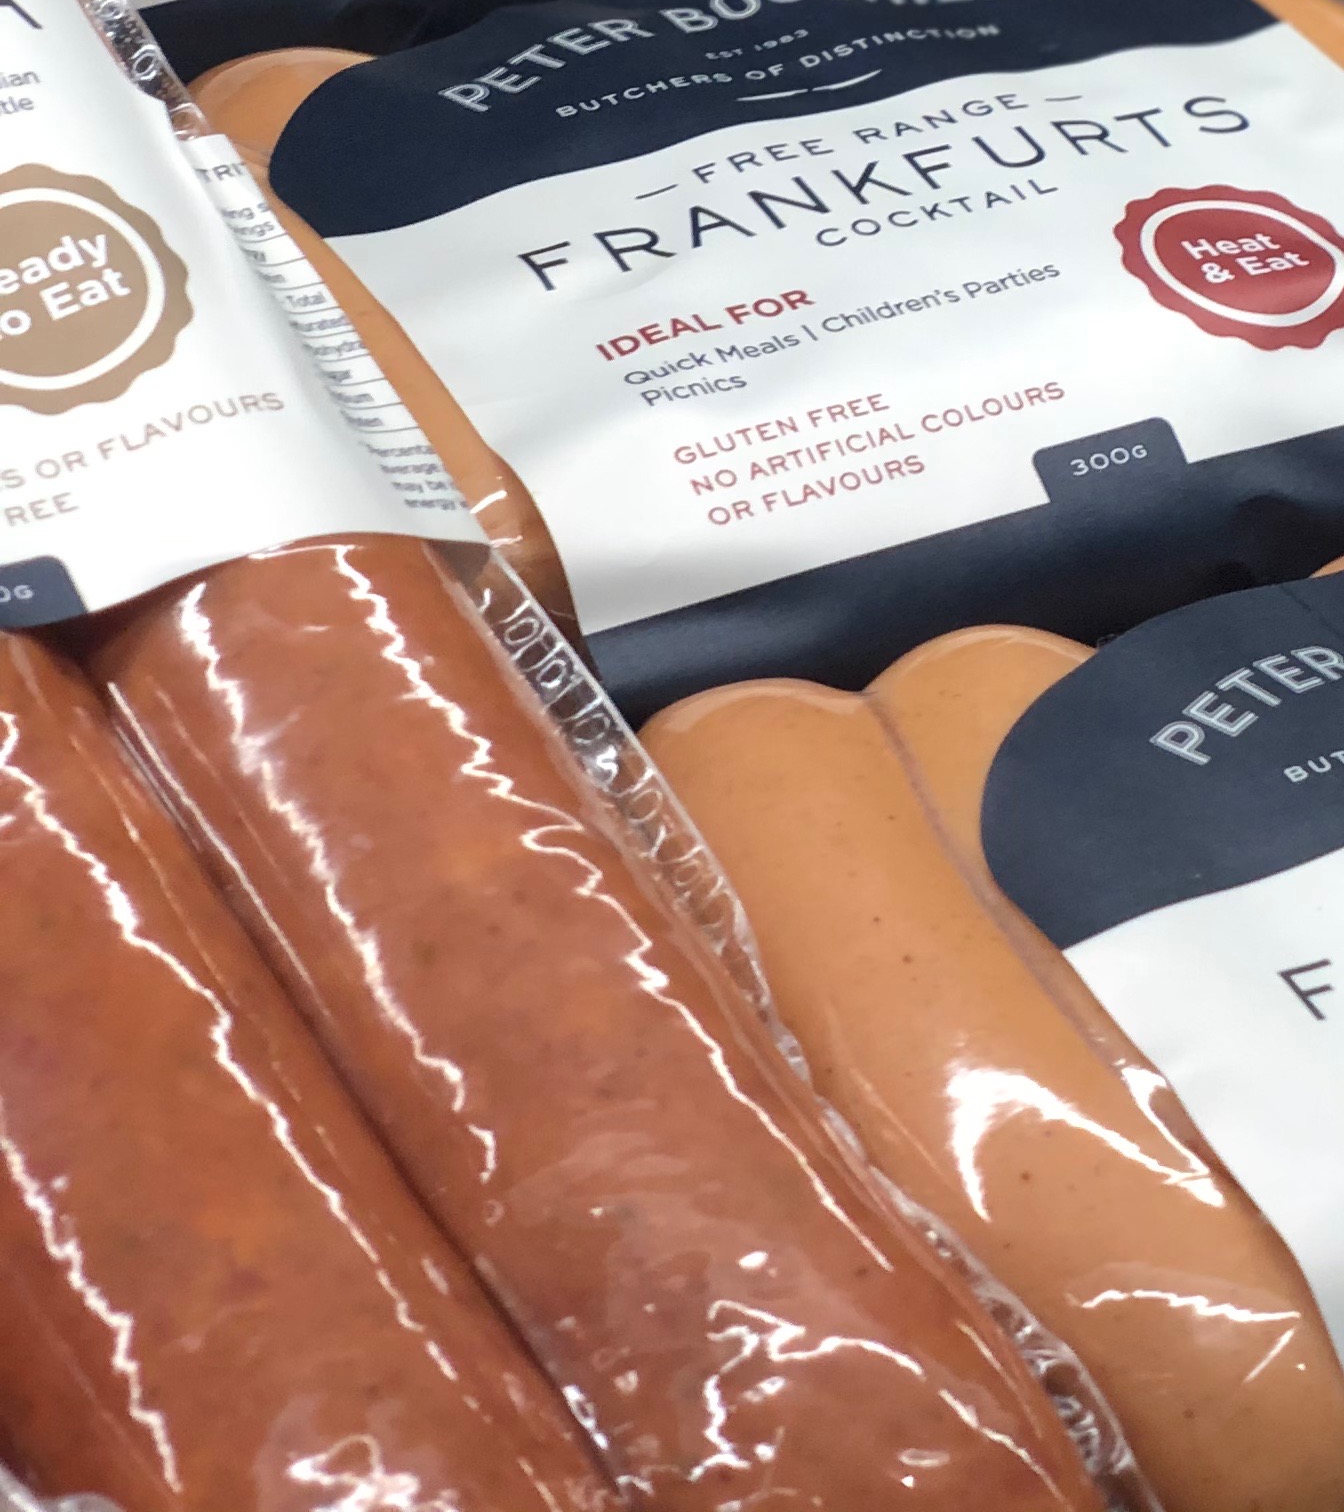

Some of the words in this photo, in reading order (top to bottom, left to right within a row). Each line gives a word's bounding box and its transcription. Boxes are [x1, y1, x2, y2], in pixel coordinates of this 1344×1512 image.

[438, 17, 655, 114] PETER
[556, 72, 733, 119] BUTCHERS
[745, 65, 785, 82] OF
[799, 24, 1000, 69] DISTINCTION
[705, 43, 744, 61] EST
[691, 137, 835, 185] FREE
[853, 92, 1029, 146] RANGE
[516, 95, 1251, 292] FRANKFURTS
[815, 177, 1059, 248] COCKTAIL
[0, 234, 110, 295] eady
[1180, 233, 1281, 260] Heat
[1201, 262, 1235, 284] &
[1235, 251, 1310, 276] Eat
[0, 308, 32, 336] o
[40, 266, 131, 320] Eat
[595, 312, 723, 361] IDEAL
[725, 289, 816, 326] FOR
[623, 351, 714, 386] Quick
[715, 328, 801, 364] Meals
[821, 286, 960, 334] Children's
[962, 261, 1061, 299] Parties
[639, 372, 747, 407] Picnics
[35, 450, 89, 479] OR
[97, 392, 285, 459] FLAVOURS
[674, 416, 800, 465] GLUTEN
[806, 392, 890, 429] FREE
[688, 467, 738, 497] NO
[748, 423, 915, 482] ARTIFICIAL
[921, 381, 1066, 434] COLOURS
[4, 492, 80, 527] REE
[707, 499, 755, 527] OR
[762, 454, 927, 512] FLAVOURS
